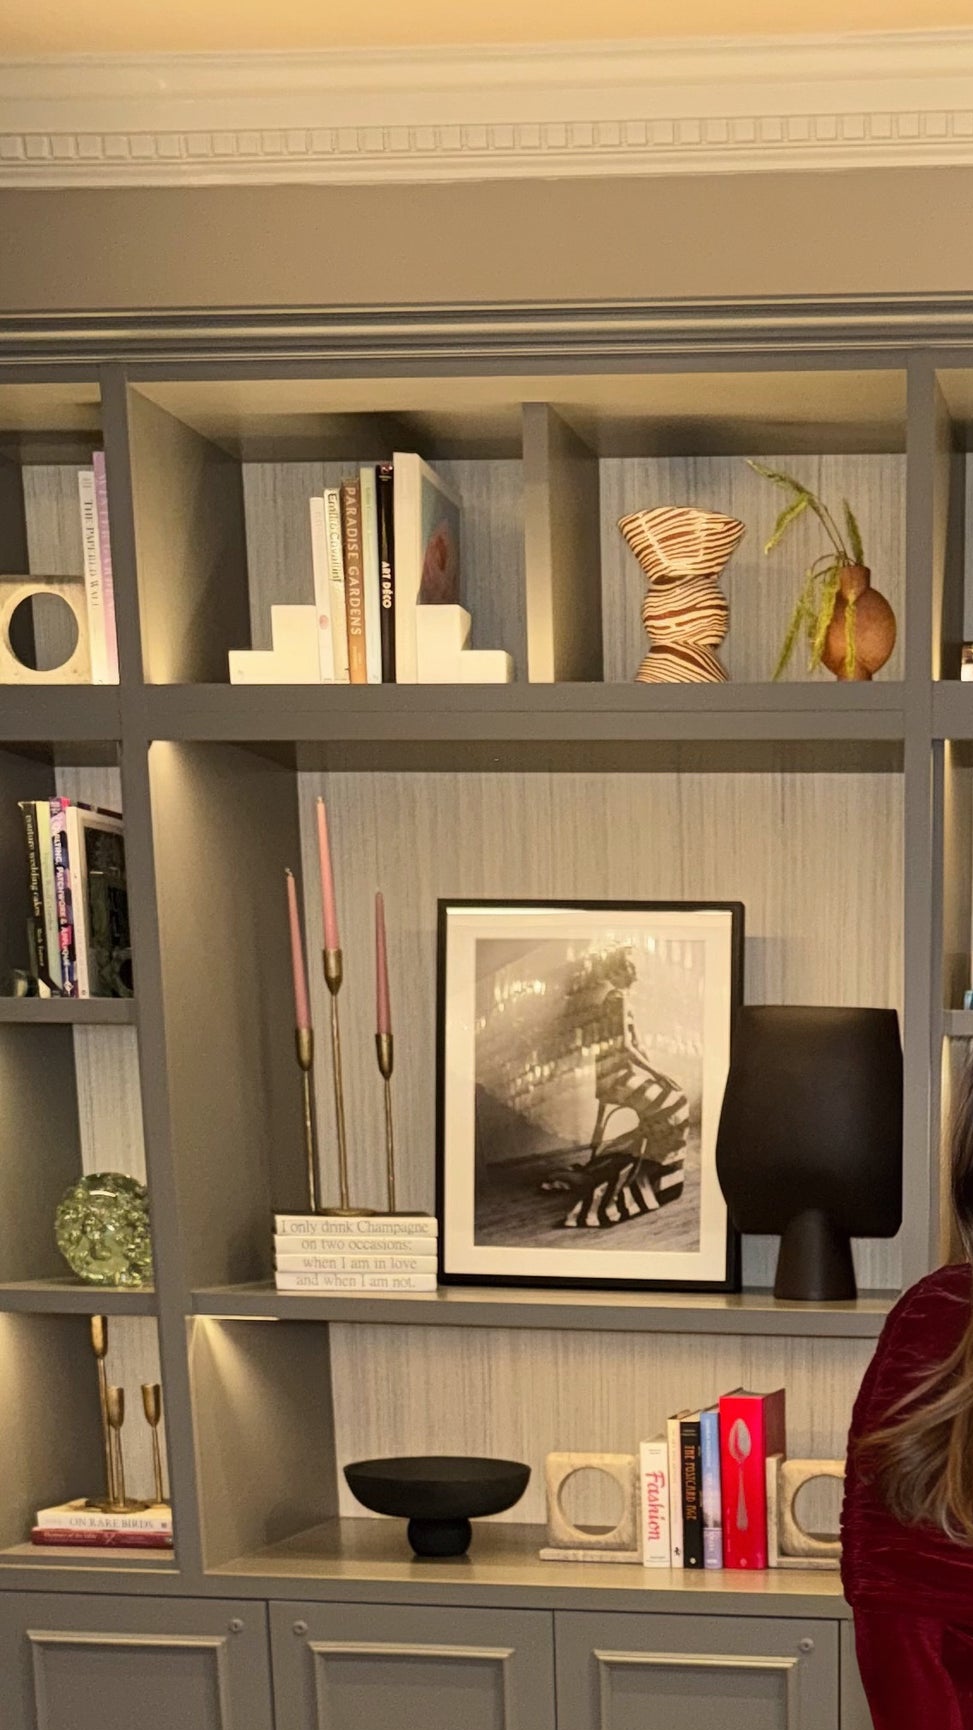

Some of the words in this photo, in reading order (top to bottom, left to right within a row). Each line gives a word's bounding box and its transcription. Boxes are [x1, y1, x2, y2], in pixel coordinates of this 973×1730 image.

[83, 499, 94, 524] THE
[344, 486, 359, 560] PARADISE
[381, 560, 391, 580] ART
[348, 566, 362, 636] GARDENS
[382, 581, 393, 609] DÉCO
[28, 852, 39, 890] wedding
[32, 892, 42, 917] cakes
[56, 867, 67, 918] PATCHWORK
[281, 1220, 286, 1233] I
[290, 1220, 317, 1235] only
[321, 1220, 355, 1233] drink
[357, 1220, 428, 1236] Champagne
[301, 1240, 317, 1250] on
[321, 1240, 345, 1250] two
[303, 1256, 336, 1270] when
[341, 1256, 346, 1269] I
[350, 1259, 370, 1270] am
[375, 1257, 386, 1269] in
[391, 1257, 417, 1270] love
[296, 1274, 319, 1286] and
[324, 1274, 356, 1287] when
[361, 1274, 365, 1287] I
[369, 1277, 389, 1287] am
[392, 1277, 416, 1288] not.
[684, 1445, 696, 1460] THE
[685, 1462, 697, 1503] POSTCARD
[645, 1470, 665, 1541] Fashion
[686, 1505, 698, 1520] AGE
[69, 1517, 87, 1527] ON
[89, 1518, 119, 1528] RARE
[121, 1519, 153, 1529] BIRDS
